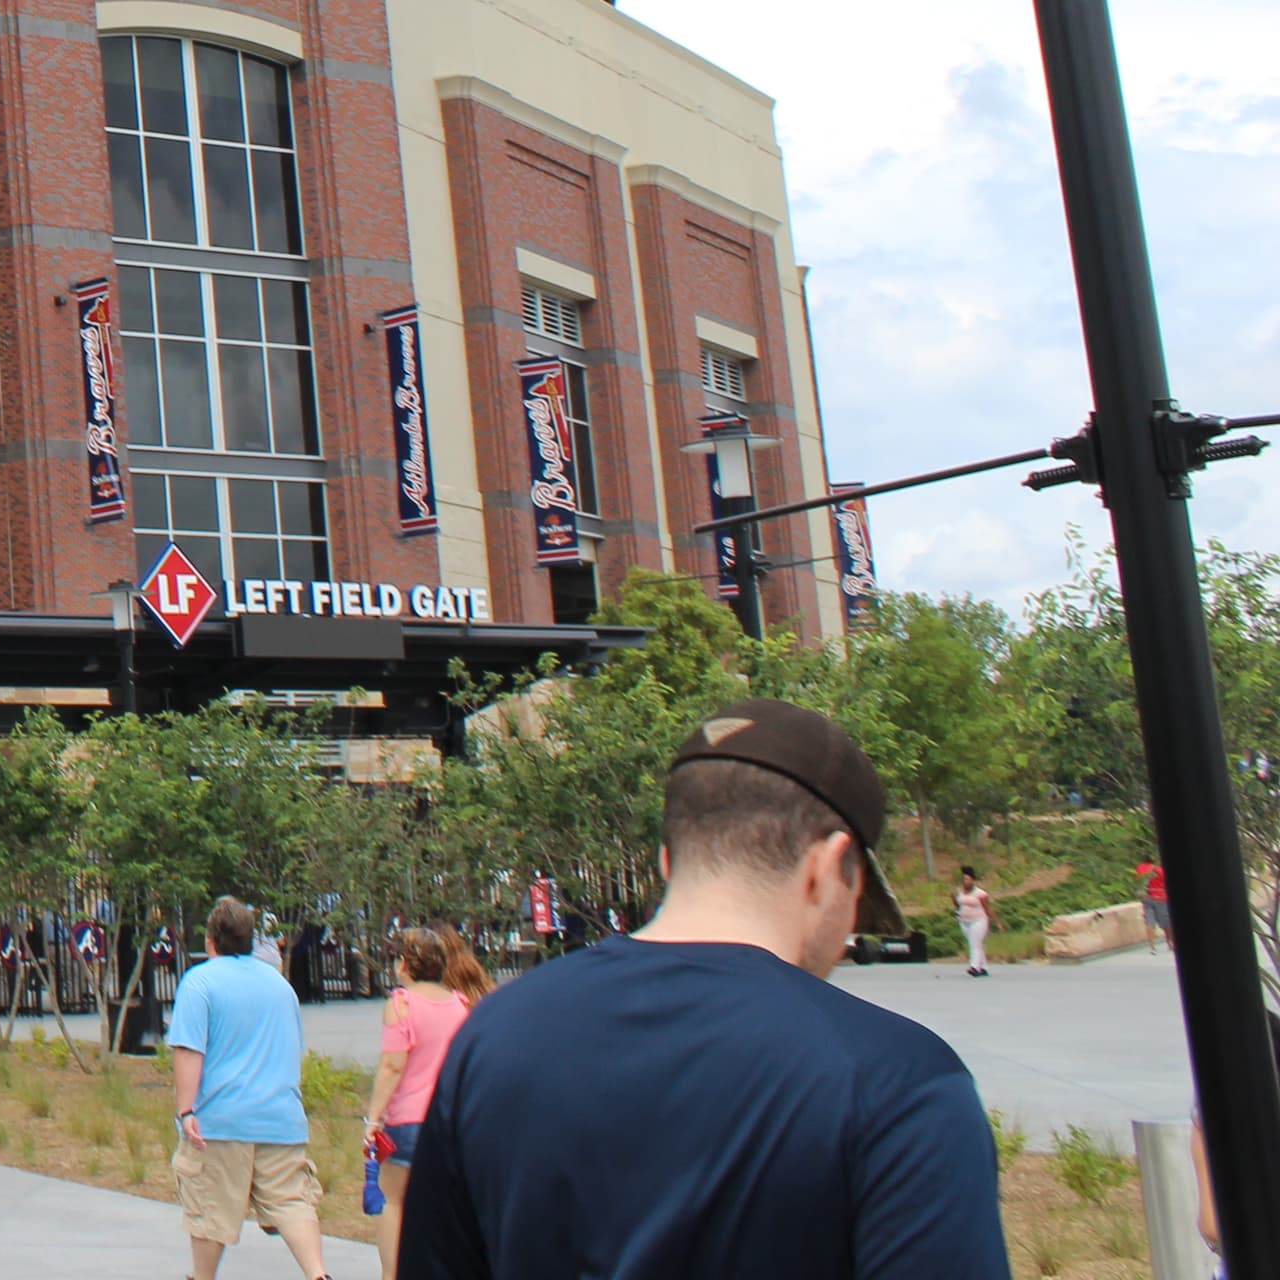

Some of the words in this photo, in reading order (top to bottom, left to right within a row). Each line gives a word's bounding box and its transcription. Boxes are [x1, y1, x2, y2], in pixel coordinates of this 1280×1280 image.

[80, 326, 118, 457] Braves
[394, 324, 423, 414] Braves
[401, 412, 431, 518] Atlanta
[523, 397, 577, 511] Braves
[156, 573, 198, 615] LF
[833, 508, 878, 597] Braves
[224, 579, 303, 617] LEFT
[311, 581, 403, 617] FIELD
[410, 586, 490, 620] GATE
